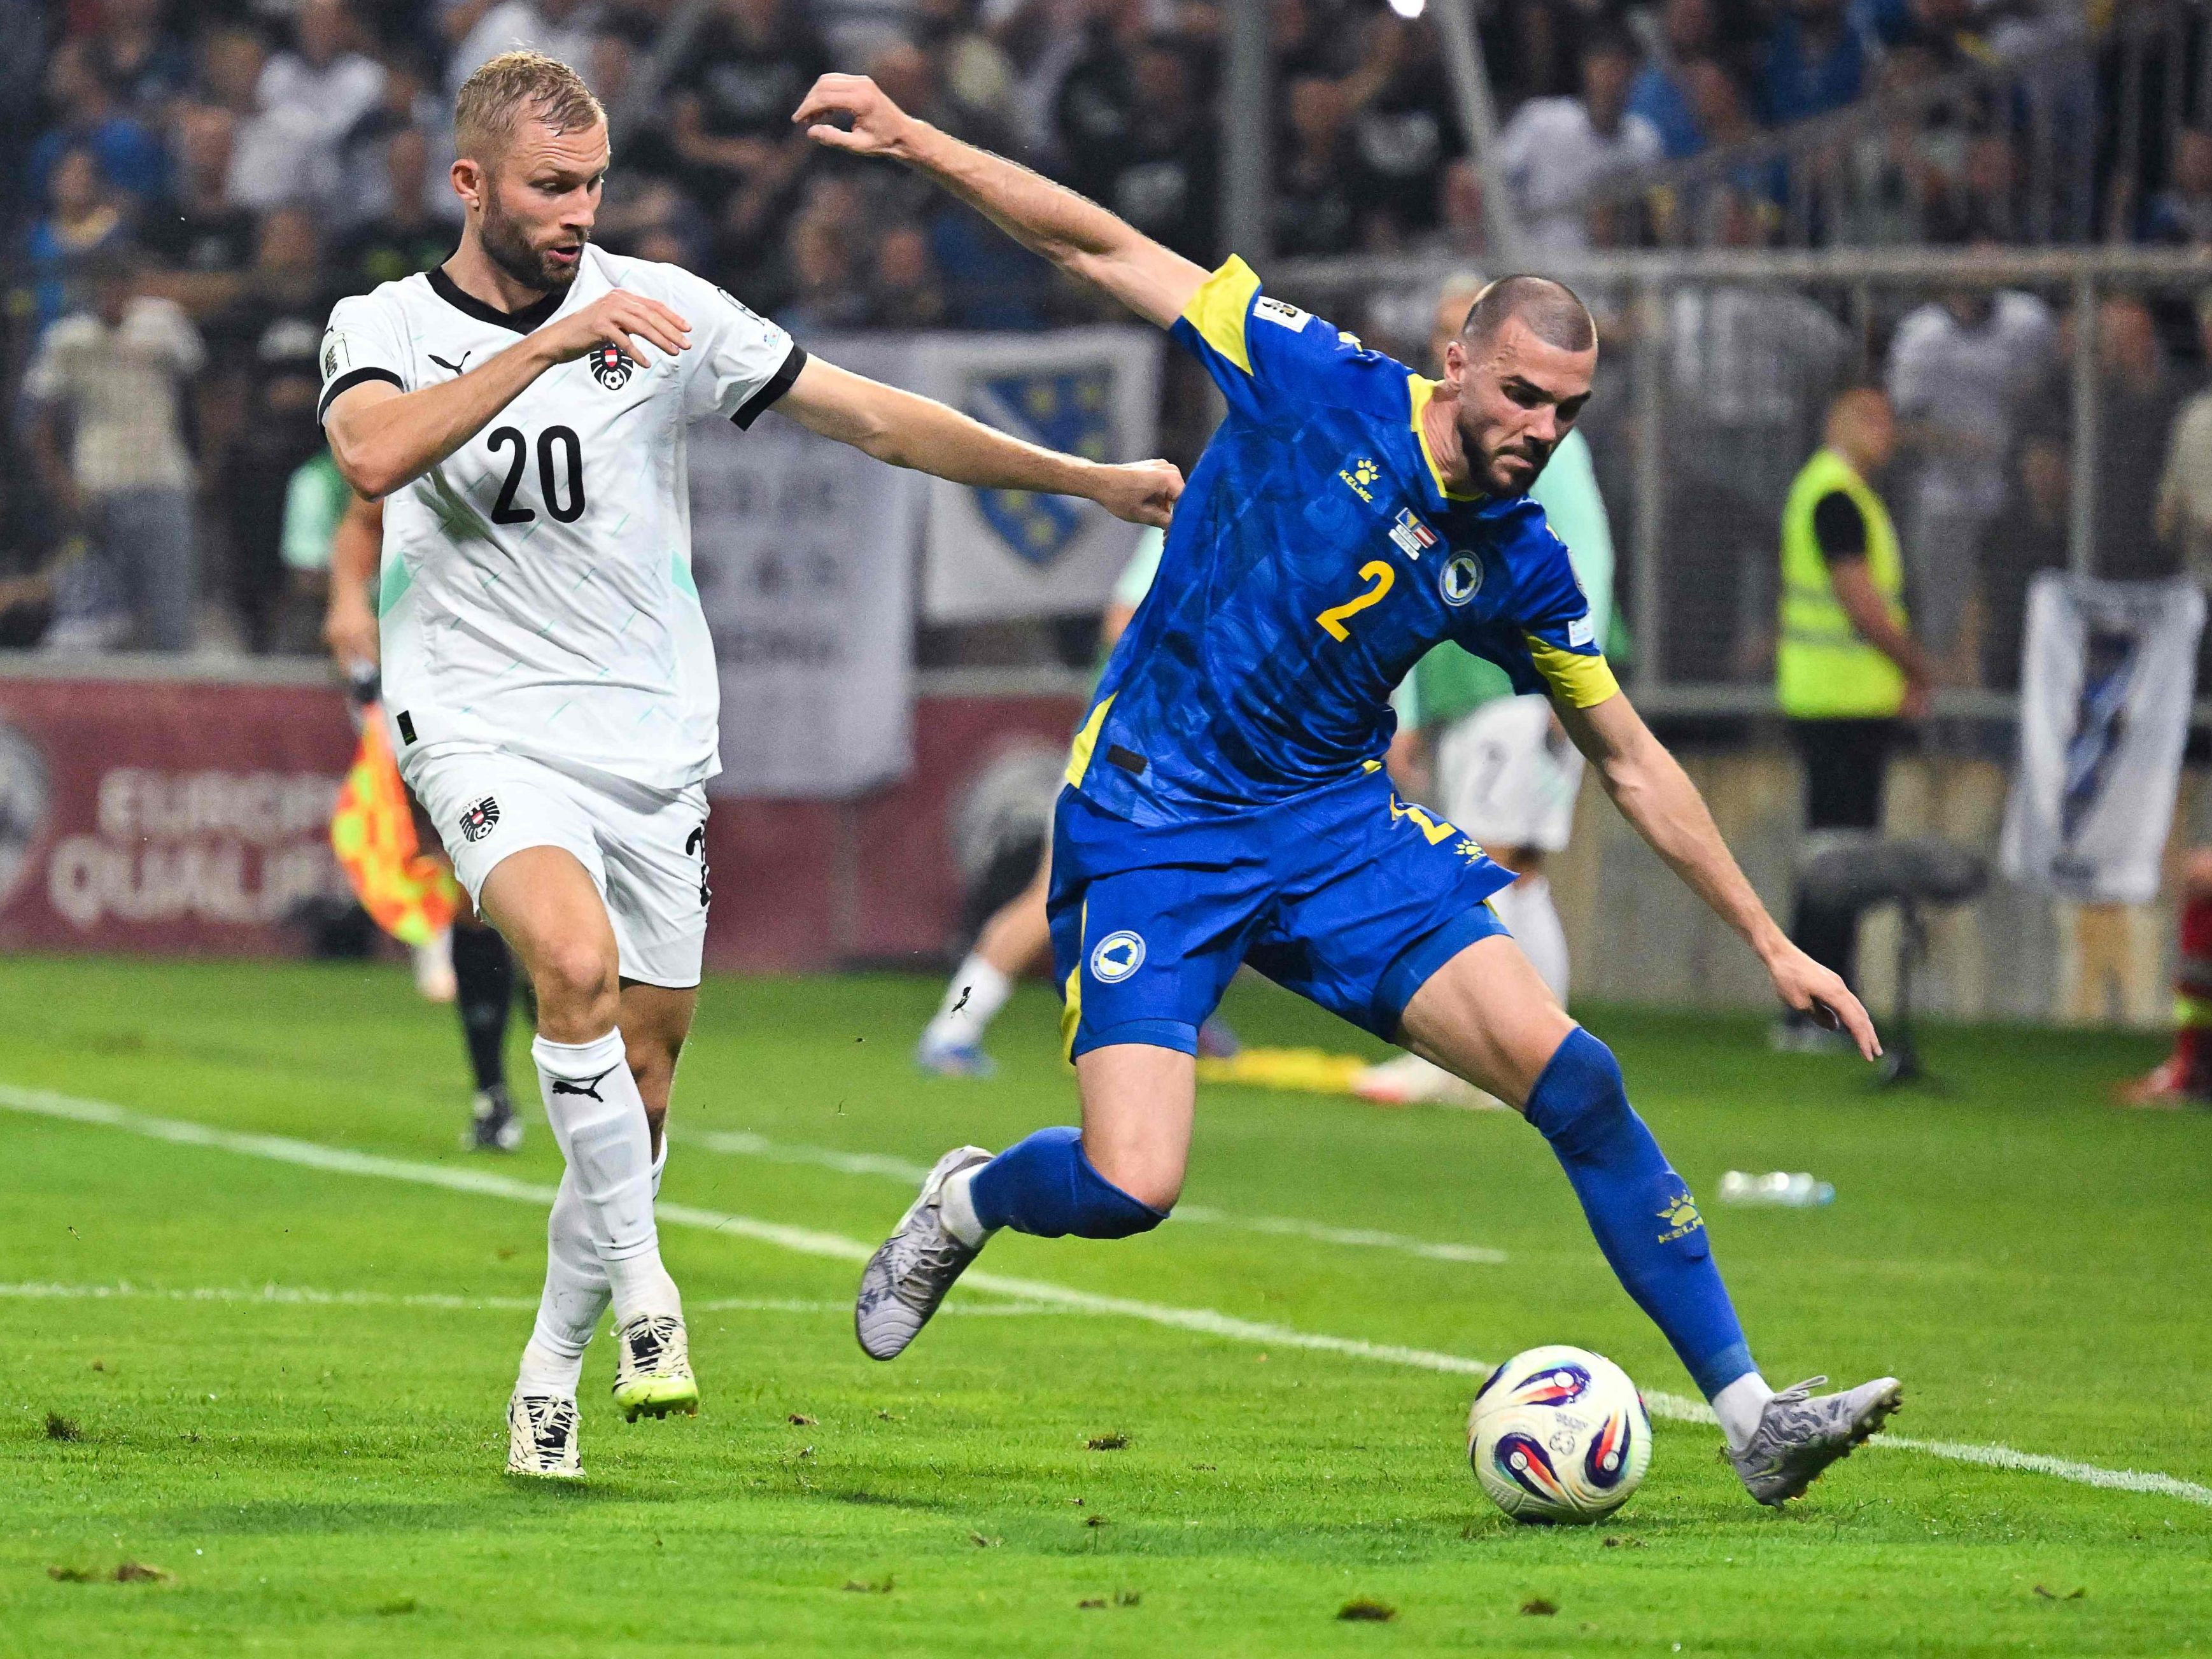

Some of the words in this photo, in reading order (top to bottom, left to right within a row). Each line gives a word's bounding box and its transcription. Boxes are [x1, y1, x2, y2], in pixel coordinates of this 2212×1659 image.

[487, 425, 585, 524] 20
[1339, 469, 1373, 503] KELME
[1316, 560, 1395, 642] 2
